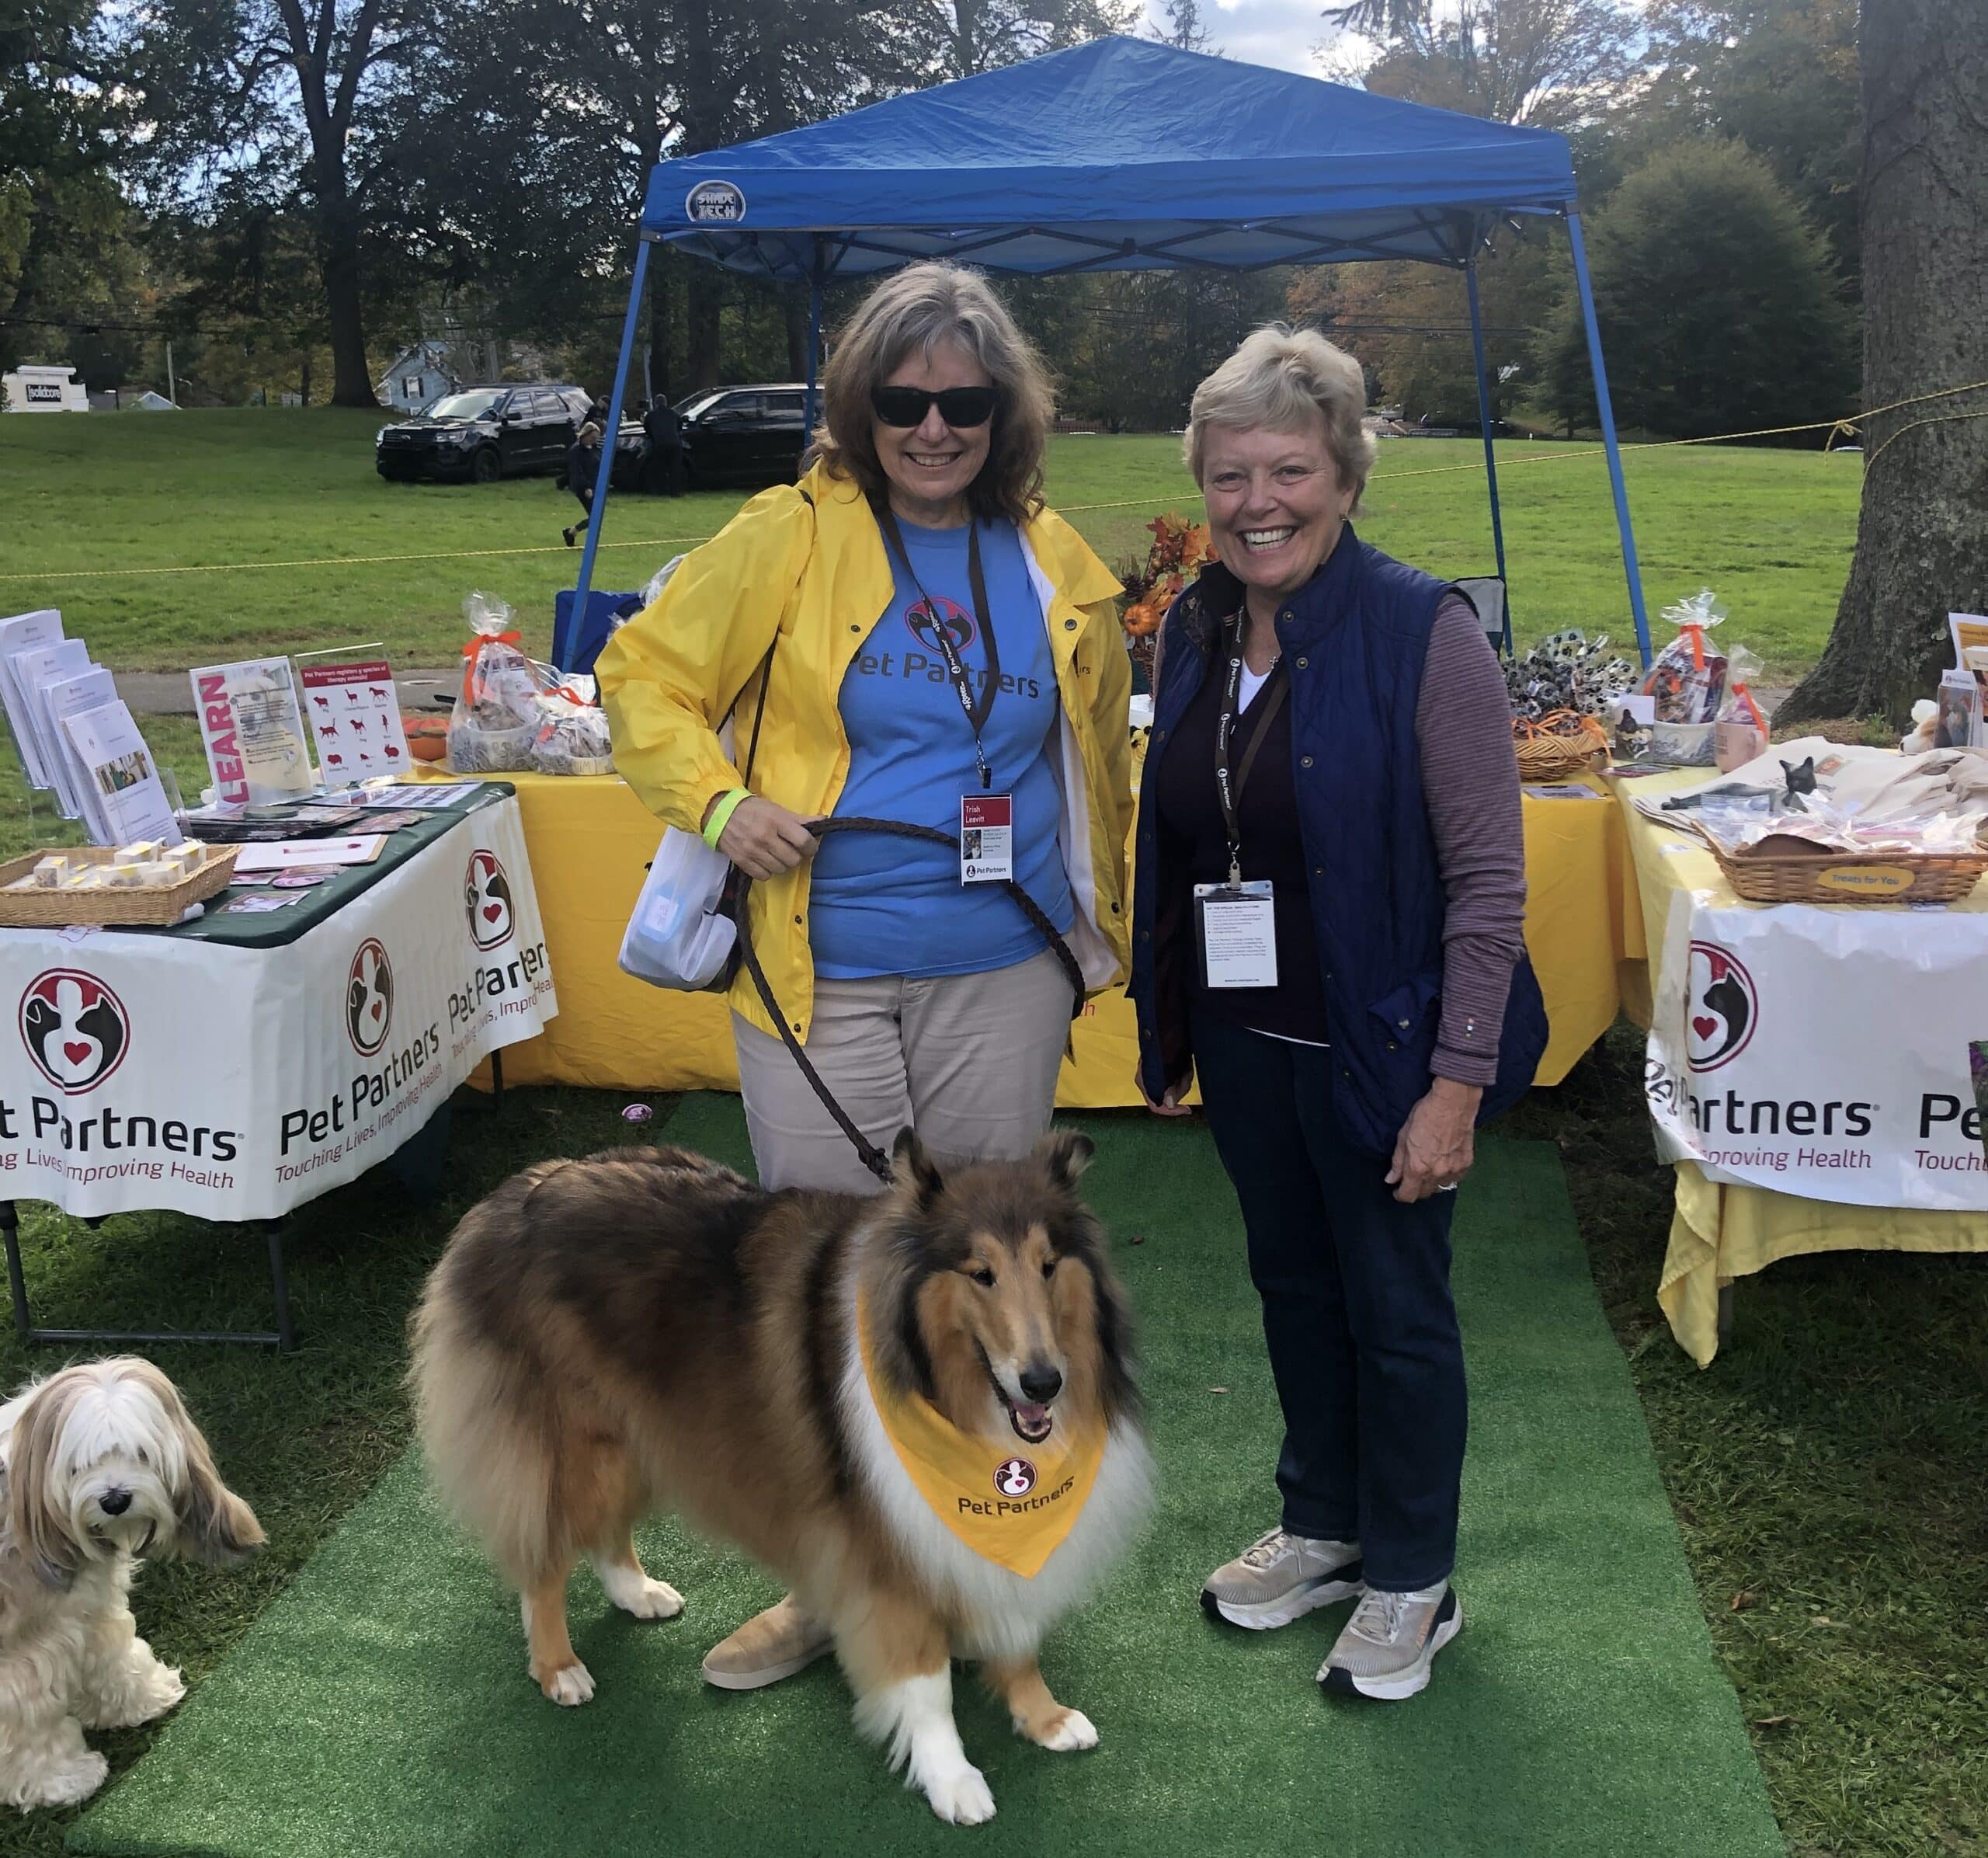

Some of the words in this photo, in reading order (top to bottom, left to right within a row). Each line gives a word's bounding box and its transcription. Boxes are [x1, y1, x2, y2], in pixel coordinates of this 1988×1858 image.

[699, 205, 735, 219] TECH
[903, 652, 1039, 698] Patners
[198, 674, 249, 804] LEARN
[1833, 875, 1861, 883] Treats
[1865, 875, 1878, 884] for
[1882, 876, 1899, 885] You
[448, 982, 475, 1034] Pet
[281, 1094, 344, 1156] Pet
[352, 1025, 440, 1122] Partners
[32, 1096, 236, 1161] Partners
[276, 1144, 342, 1183] Touching
[346, 1127, 377, 1152] Lives,
[378, 1086, 419, 1131] Improving
[420, 1062, 443, 1091] Health
[171, 1161, 234, 1188] Health
[1797, 1147, 1872, 1169] Health
[958, 1498, 993, 1515] Pet
[997, 1476, 1075, 1516] Partners
